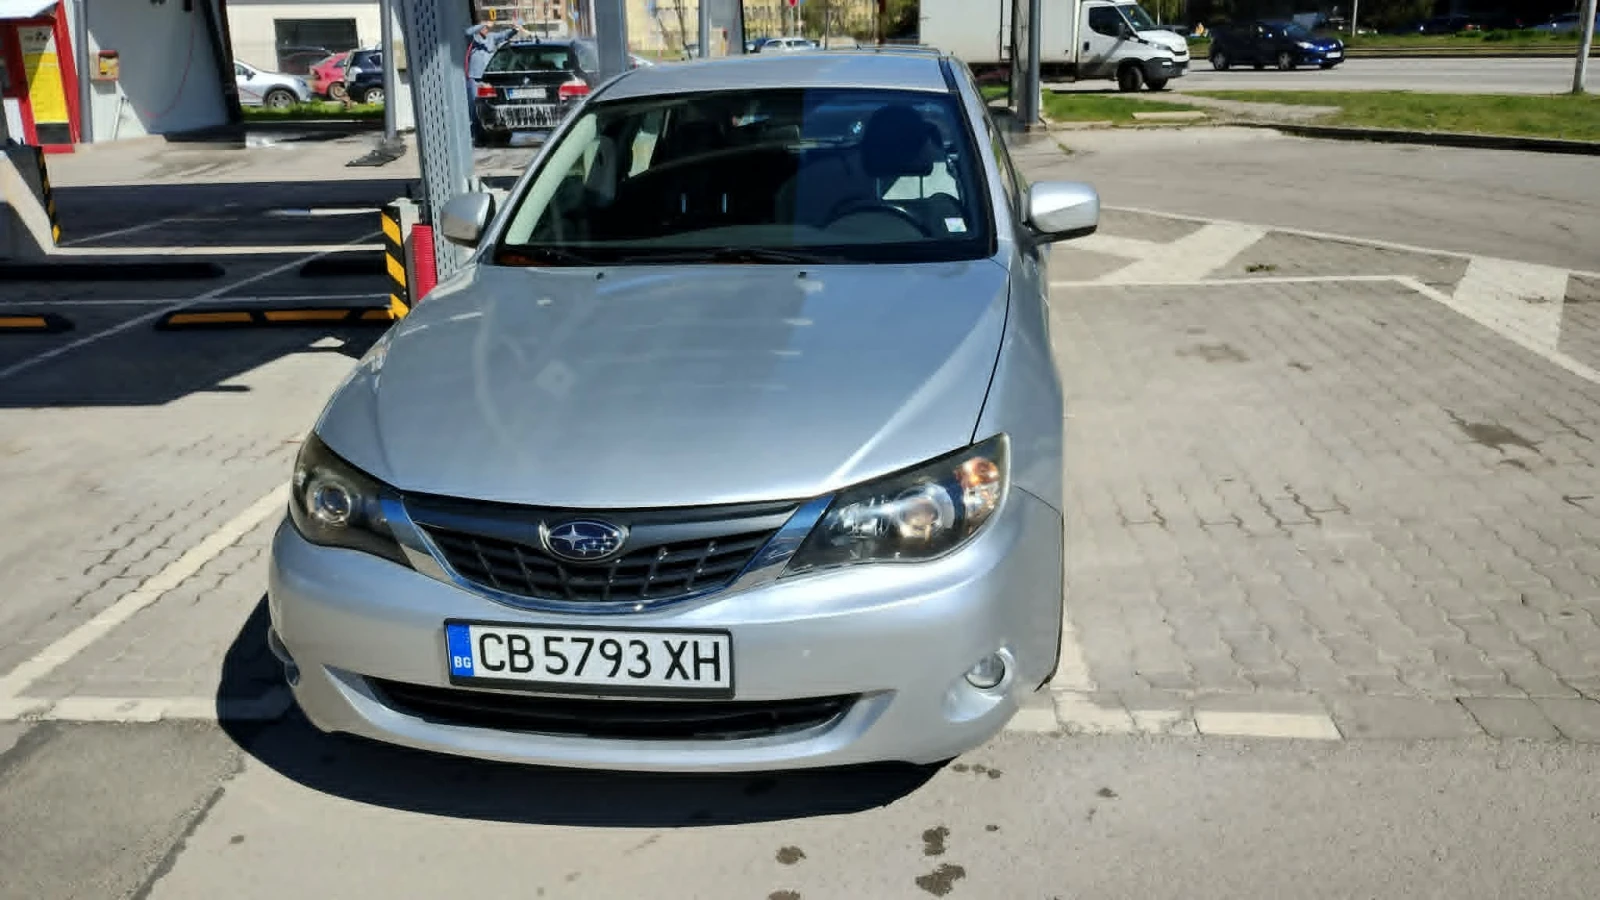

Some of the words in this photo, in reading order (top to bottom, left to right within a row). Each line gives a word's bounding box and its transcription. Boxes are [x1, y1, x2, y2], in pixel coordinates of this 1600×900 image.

[454, 656, 471, 669] BG
[479, 633, 534, 673] CB
[544, 636, 651, 678] 5793
[663, 640, 720, 681] XH
